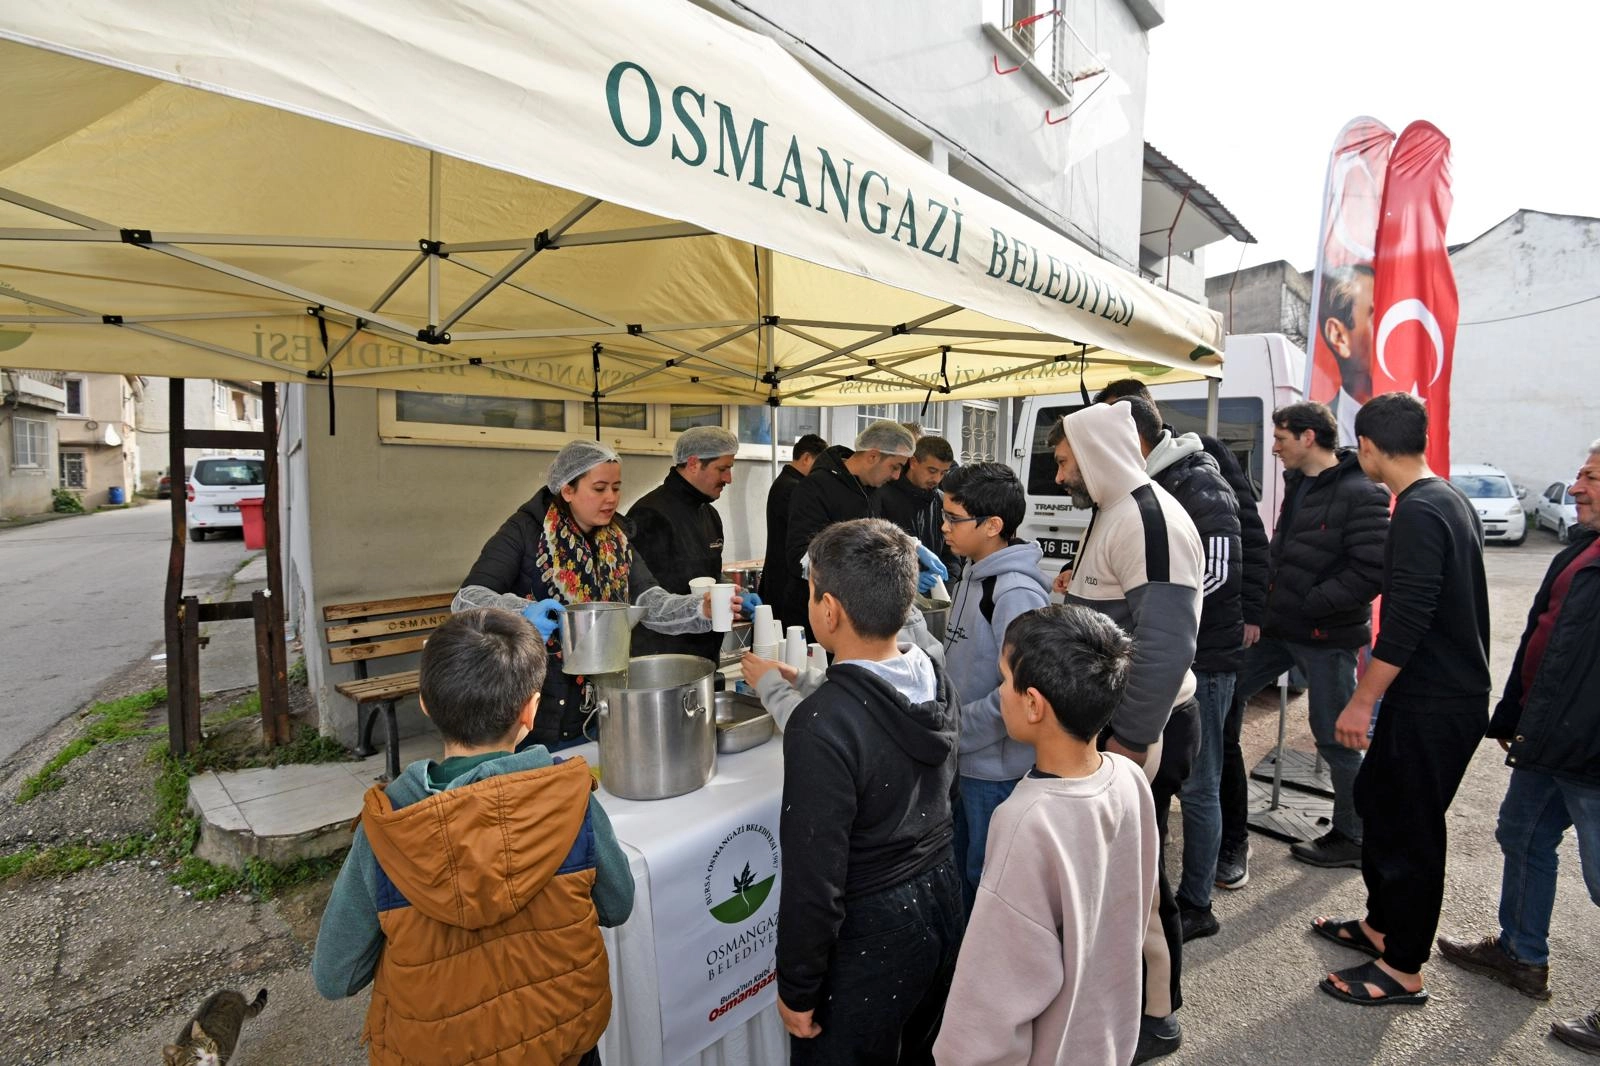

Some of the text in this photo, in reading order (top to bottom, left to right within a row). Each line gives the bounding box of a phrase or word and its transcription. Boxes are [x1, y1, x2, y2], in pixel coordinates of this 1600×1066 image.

[605, 60, 965, 265] OSMANGAZİ
[1034, 503, 1074, 512] TRANSIT
[1043, 541, 1056, 553] 16
[707, 824, 745, 872] OSMANGAZİ
[704, 874, 713, 906] BURSA
[706, 912, 779, 966] OSMANGAZ
